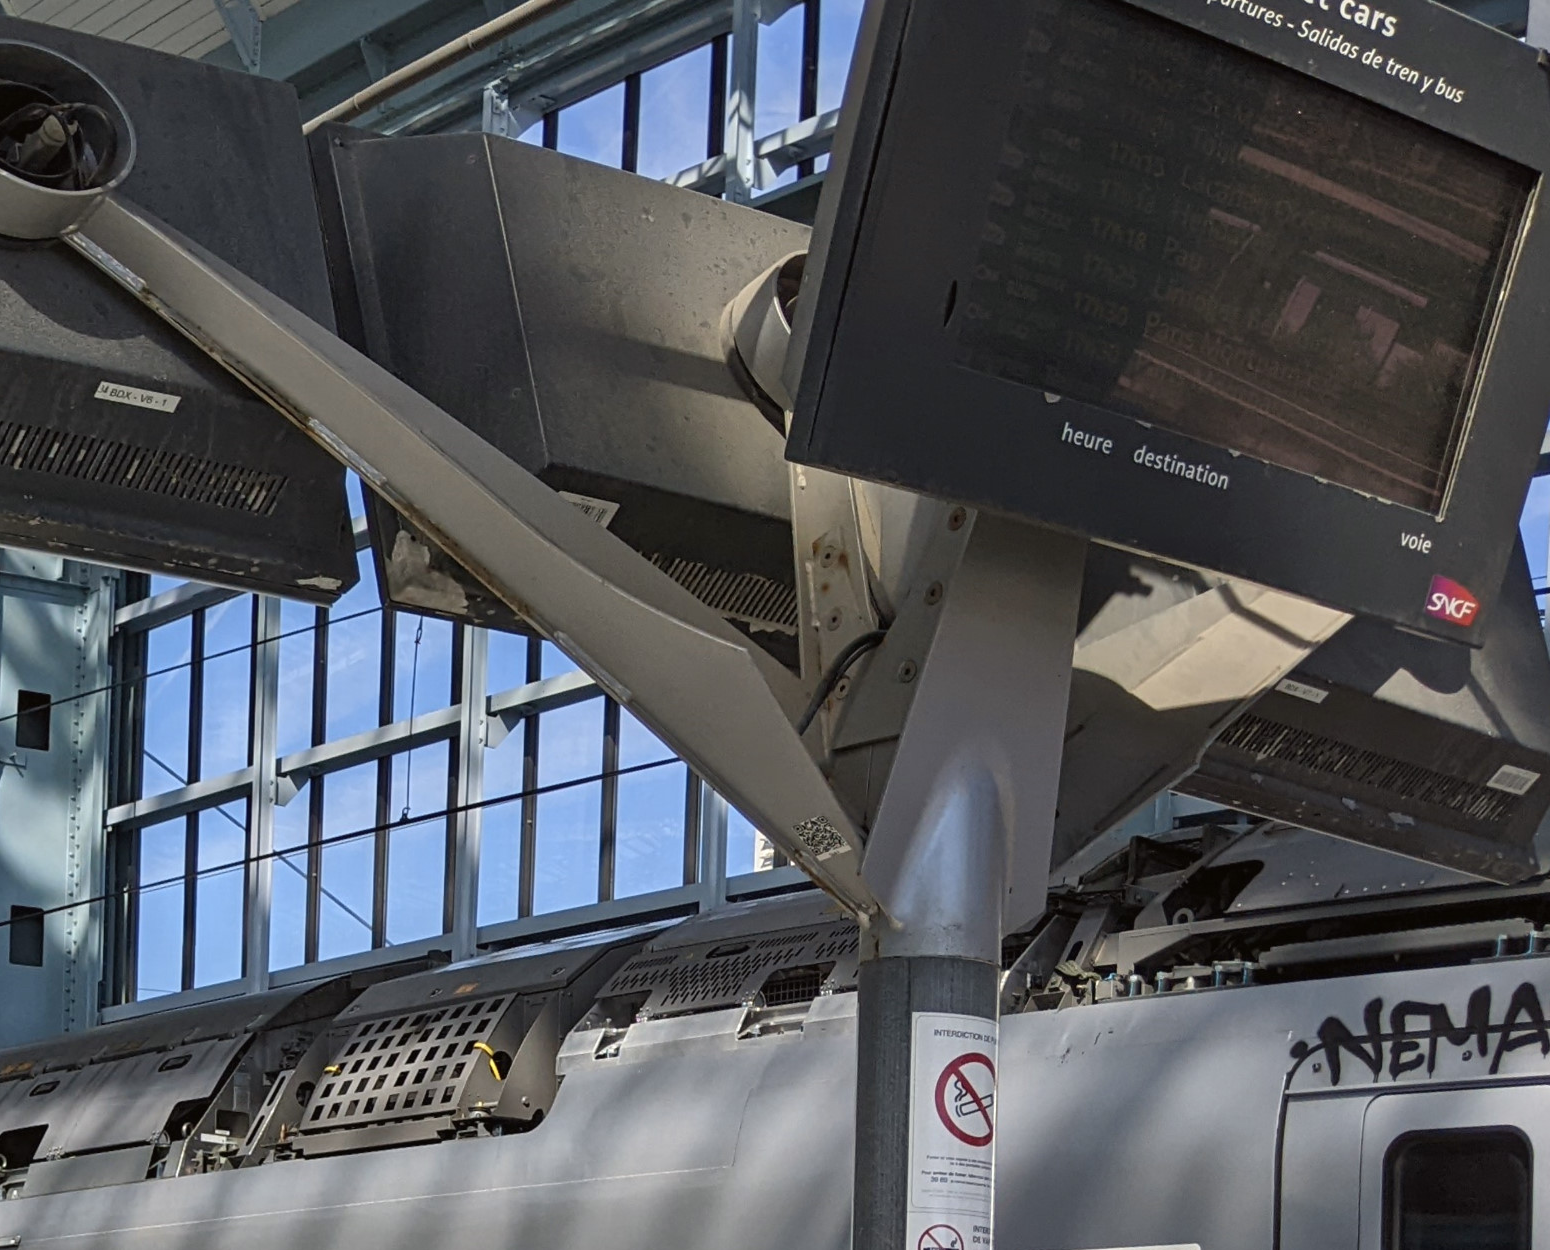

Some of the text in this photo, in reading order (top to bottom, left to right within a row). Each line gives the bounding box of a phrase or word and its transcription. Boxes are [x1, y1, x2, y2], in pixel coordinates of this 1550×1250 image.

[1339, 0, 1398, 37] cars
[1297, 20, 1360, 59] Salidas
[1361, 49, 1384, 70] de
[1385, 59, 1419, 86] tren
[1419, 75, 1434, 94] y
[1435, 77, 1466, 104] bus
[1061, 422, 1230, 490] heure destination
[1400, 531, 1433, 554] voie
[1426, 593, 1476, 619] SNCF
[934, 1029, 983, 1041] INTERDICTION
